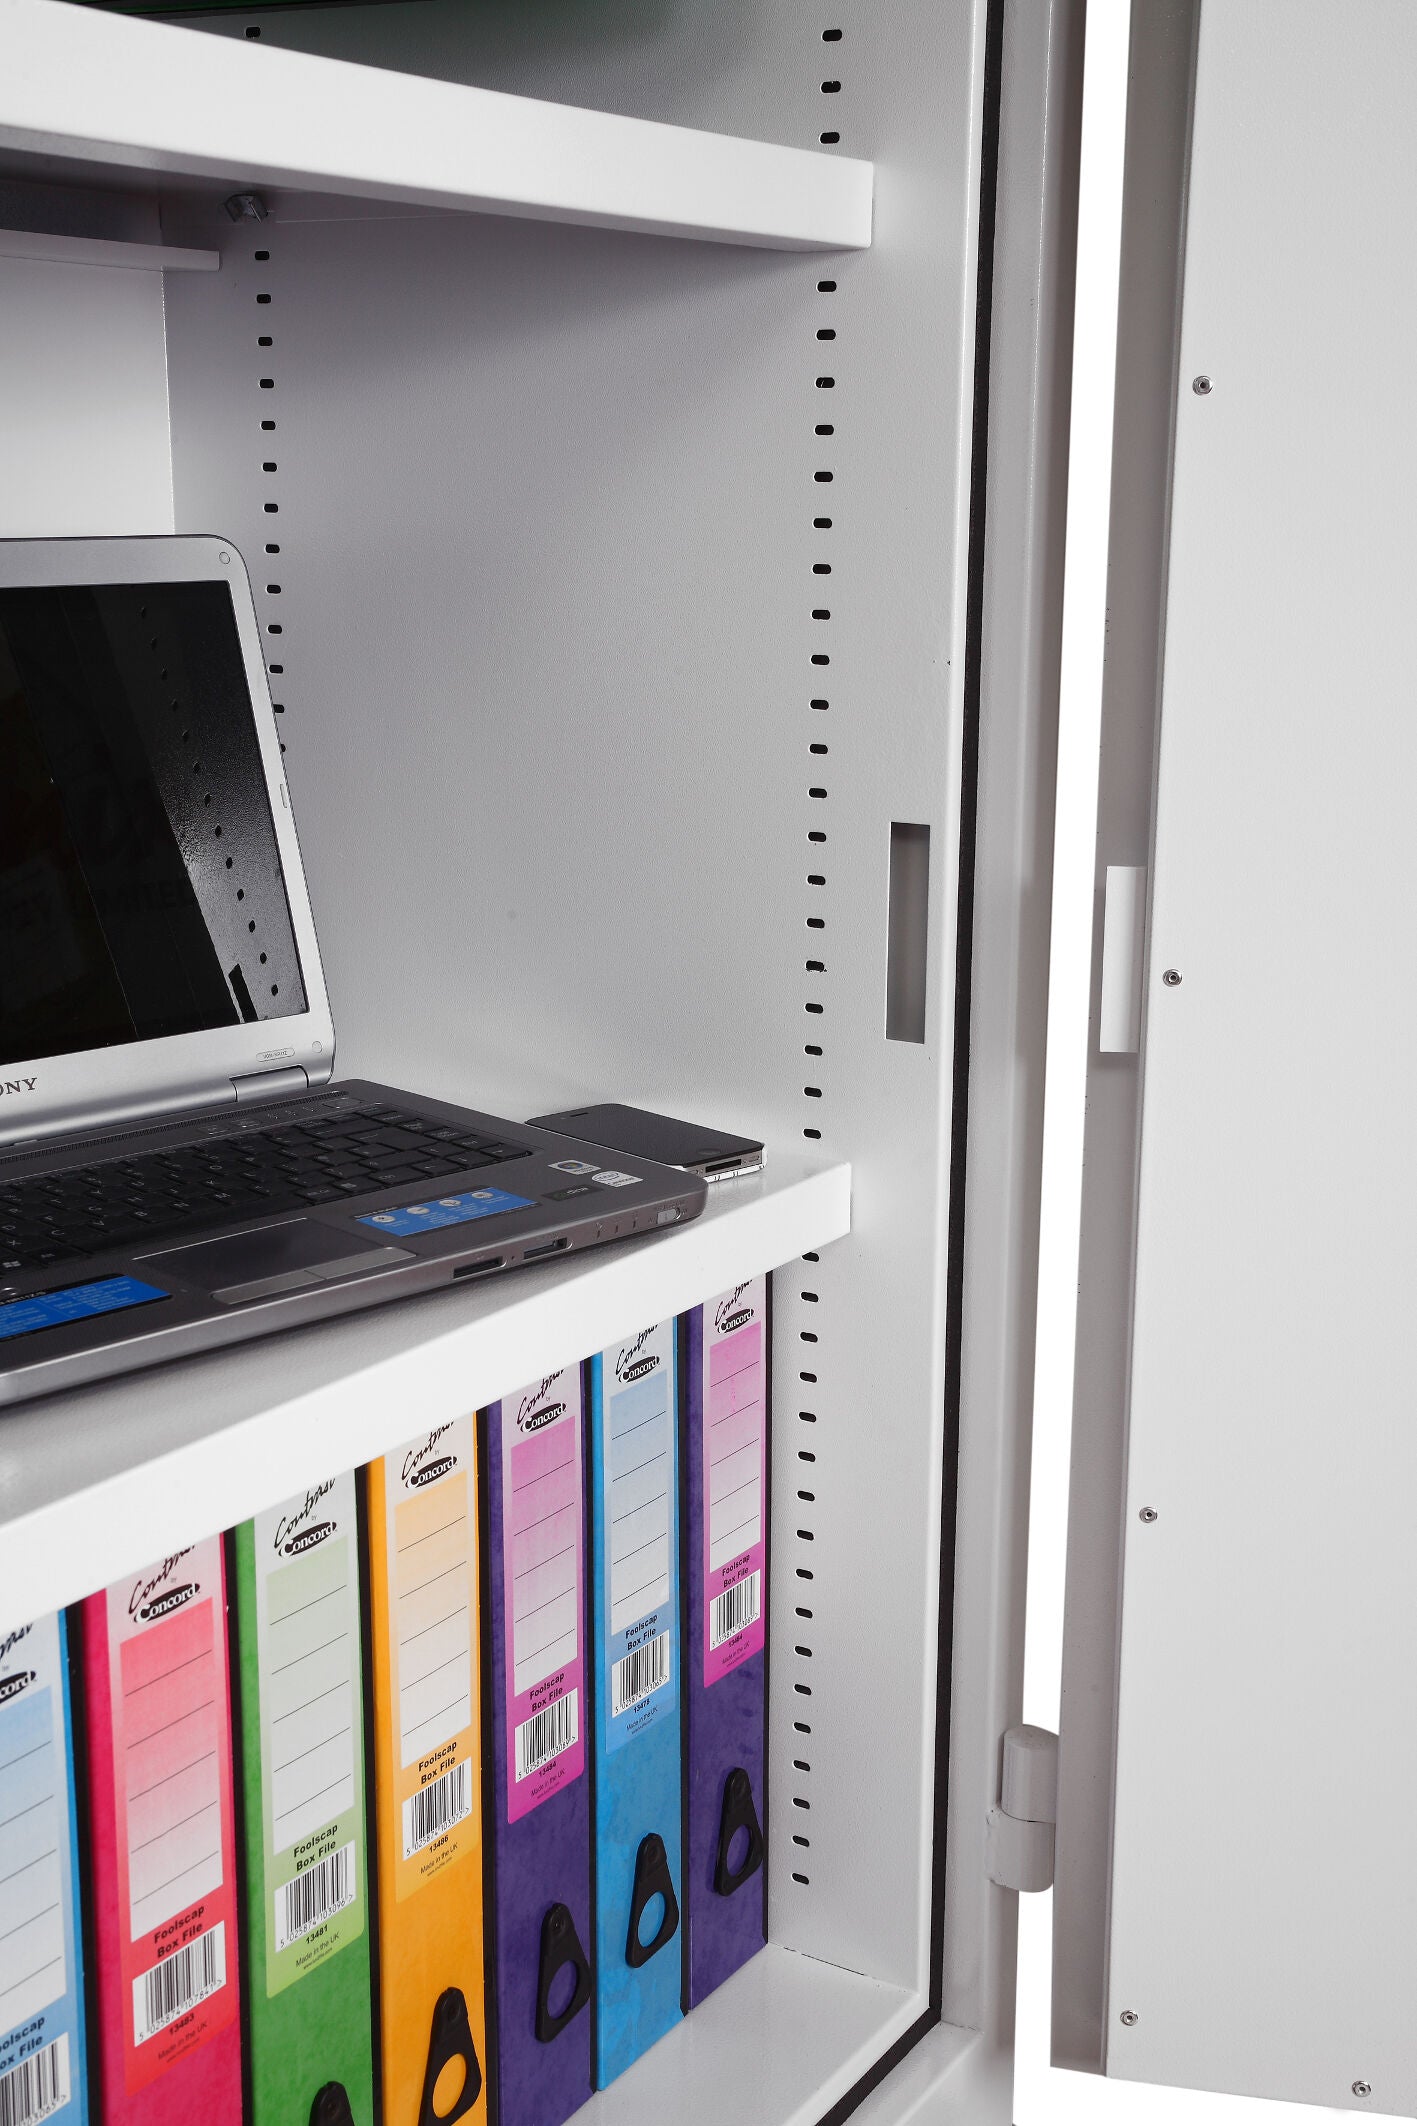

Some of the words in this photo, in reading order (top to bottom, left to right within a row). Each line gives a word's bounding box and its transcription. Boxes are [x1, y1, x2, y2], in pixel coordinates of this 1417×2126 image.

[717, 1308, 755, 1333] Concord
[618, 1355, 660, 1383] Concord
[520, 1402, 567, 1432] Concord
[405, 1455, 458, 1489] Concord
[279, 1521, 337, 1558] Concord
[722, 1554, 750, 1577] Foolscap
[723, 1575, 736, 1588] Box
[737, 1567, 748, 1579] File
[134, 1583, 200, 1623] Concord
[626, 1614, 658, 1639] Foolscap
[627, 1637, 641, 1651] Box
[643, 1628, 656, 1641] File
[529, 1673, 564, 1700] Foolscap
[531, 1698, 547, 1712] Box
[548, 1687, 563, 1701] File
[418, 1741, 457, 1772] Foolscap
[421, 1769, 438, 1785] Box
[440, 1757, 456, 1772] File
[293, 1824, 338, 1858] Foolscap
[429, 1834, 449, 1853] 13486
[296, 1854, 315, 1872] Box
[318, 1841, 336, 1858] File
[154, 1906, 205, 1944] Foolscap
[305, 1924, 328, 1945] 13481
[157, 1939, 179, 1958] Box
[182, 1924, 202, 1942] File
[295, 1952, 312, 1967] Made
[329, 1931, 340, 1943] UK
[0, 2017, 45, 2053] olscap
[169, 2012, 195, 2035] 13483
[0, 2055, 15, 2070] ox
[20, 2036, 43, 2057] File
